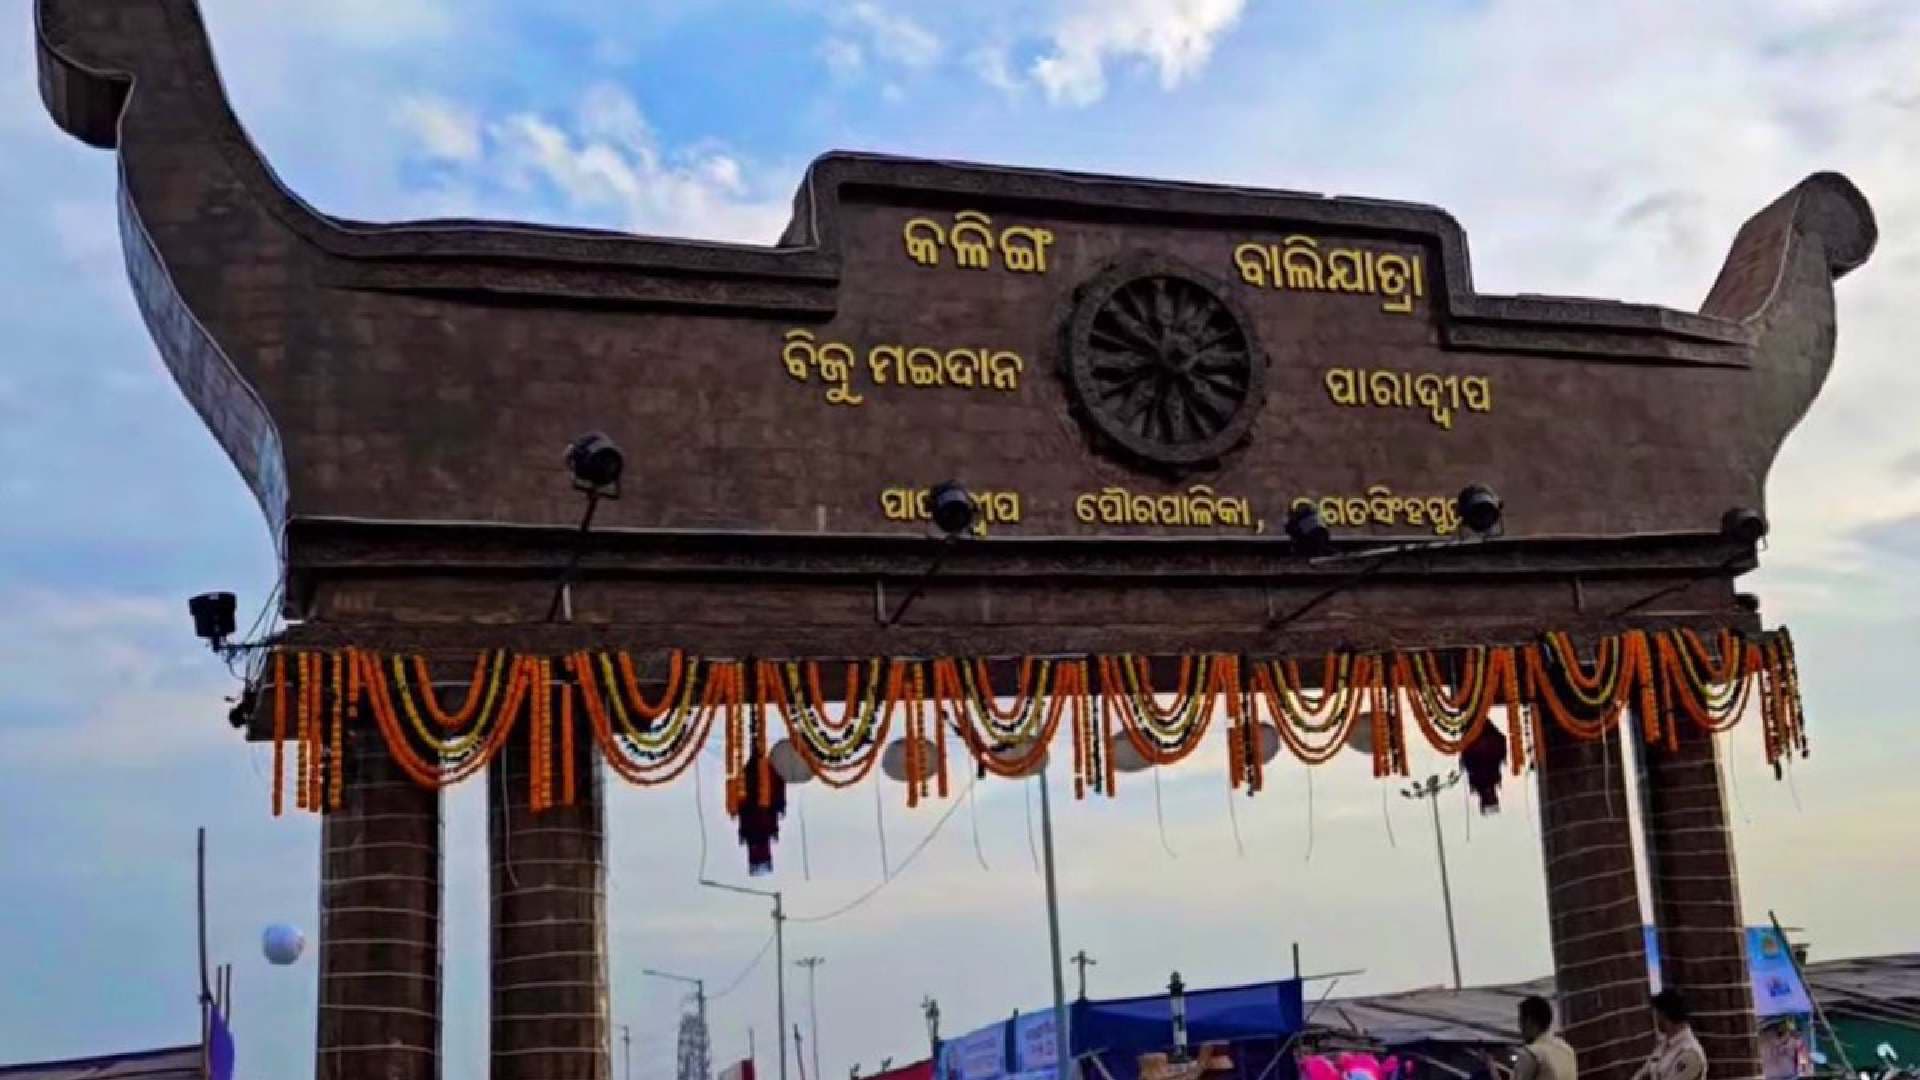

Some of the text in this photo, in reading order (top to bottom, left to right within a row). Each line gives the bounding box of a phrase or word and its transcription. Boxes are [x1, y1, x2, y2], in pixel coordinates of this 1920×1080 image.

[904, 211, 1422, 312] କଳିଙ୍ଗ ବାଲିଯାତ୍ରା
[783, 329, 863, 404] ବିଜୁ
[868, 345, 1023, 390] ମଇଦାନ
